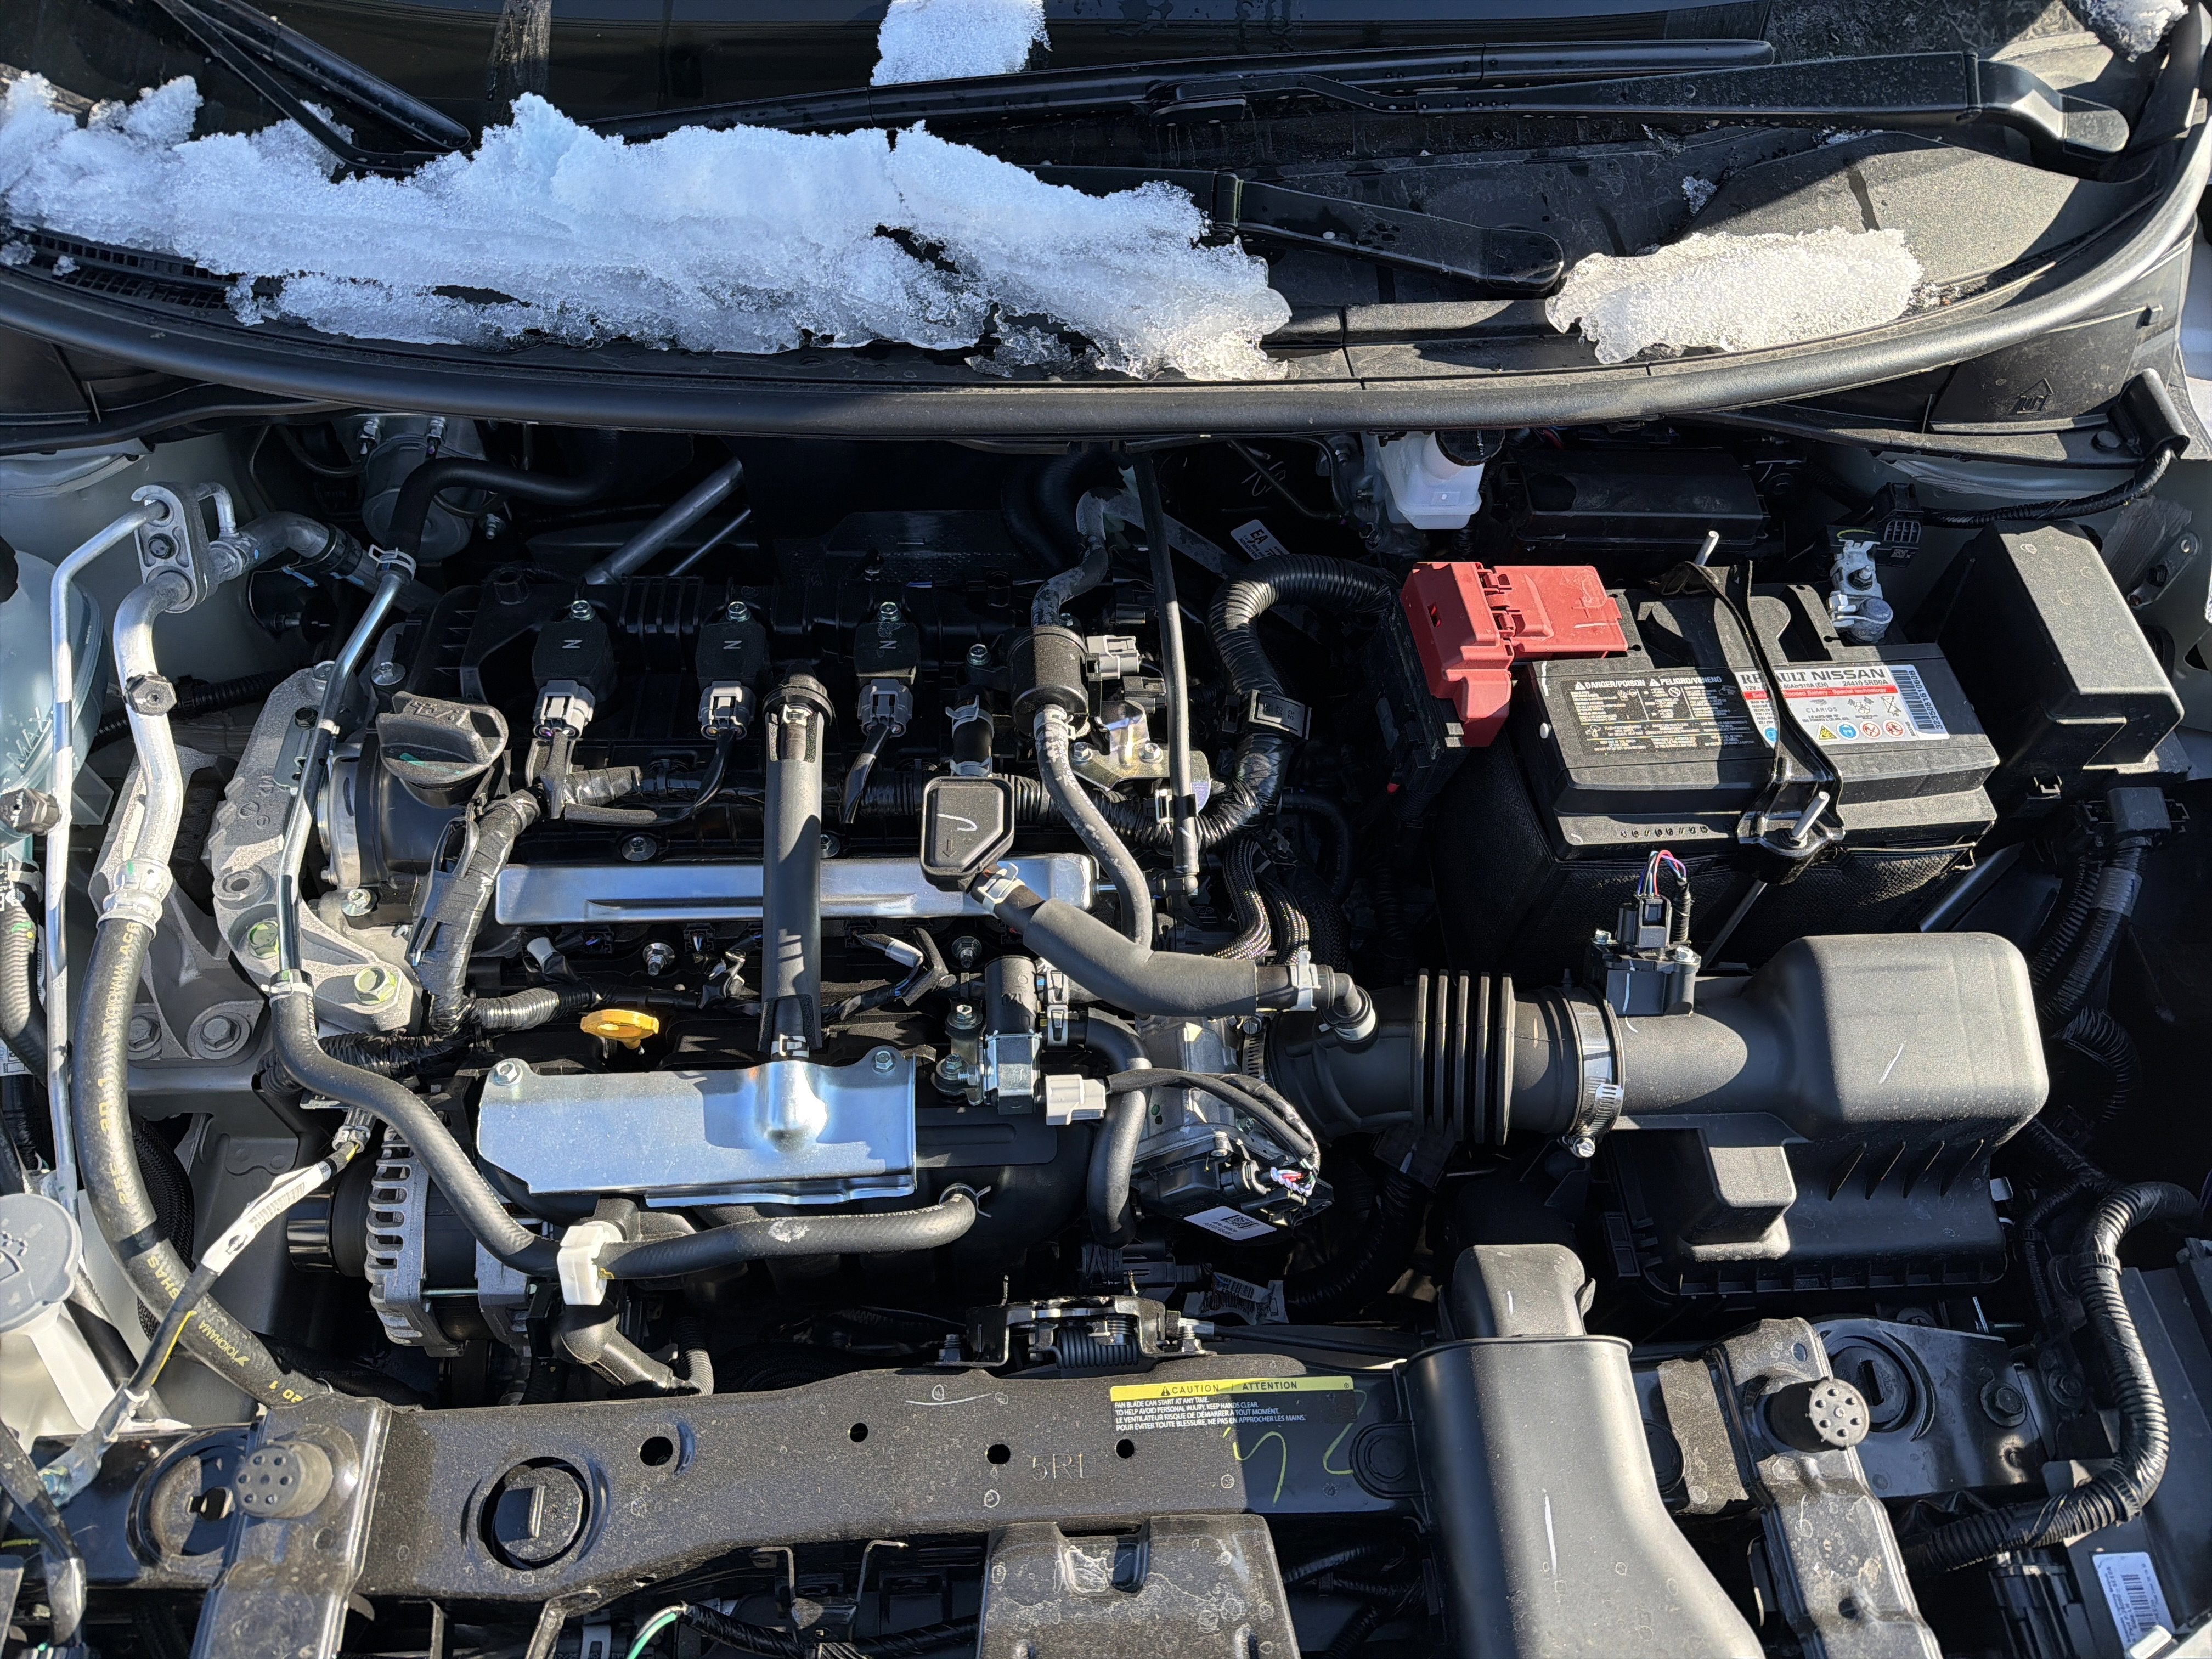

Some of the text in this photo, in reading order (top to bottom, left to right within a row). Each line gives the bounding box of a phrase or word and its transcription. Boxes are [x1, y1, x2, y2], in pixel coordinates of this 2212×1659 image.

[1250, 528, 1268, 544] EA
[1660, 676, 1722, 685] PELIGRO/VENENO
[1811, 669, 1886, 680] NISSAN
[1584, 679, 1646, 689] DANGER/POISON
[6, 707, 52, 768] MAX
[104, 964, 125, 1022] YOKOHAMA
[198, 1321, 242, 1363] YOKOHAMA
[1172, 1384, 1220, 1394] CAUTION
[1242, 1381, 1297, 1390] ATTENTION
[1126, 1400, 1144, 1408] BLADE
[1157, 1406, 1186, 1414] PERSONAL
[1124, 1414, 1163, 1423] VENTILATEUR
[1164, 1412, 1186, 1420] RISQUE
[1197, 1409, 1229, 1418] DÉMARRER
[1176, 1419, 1207, 1427] BLESSURE,
